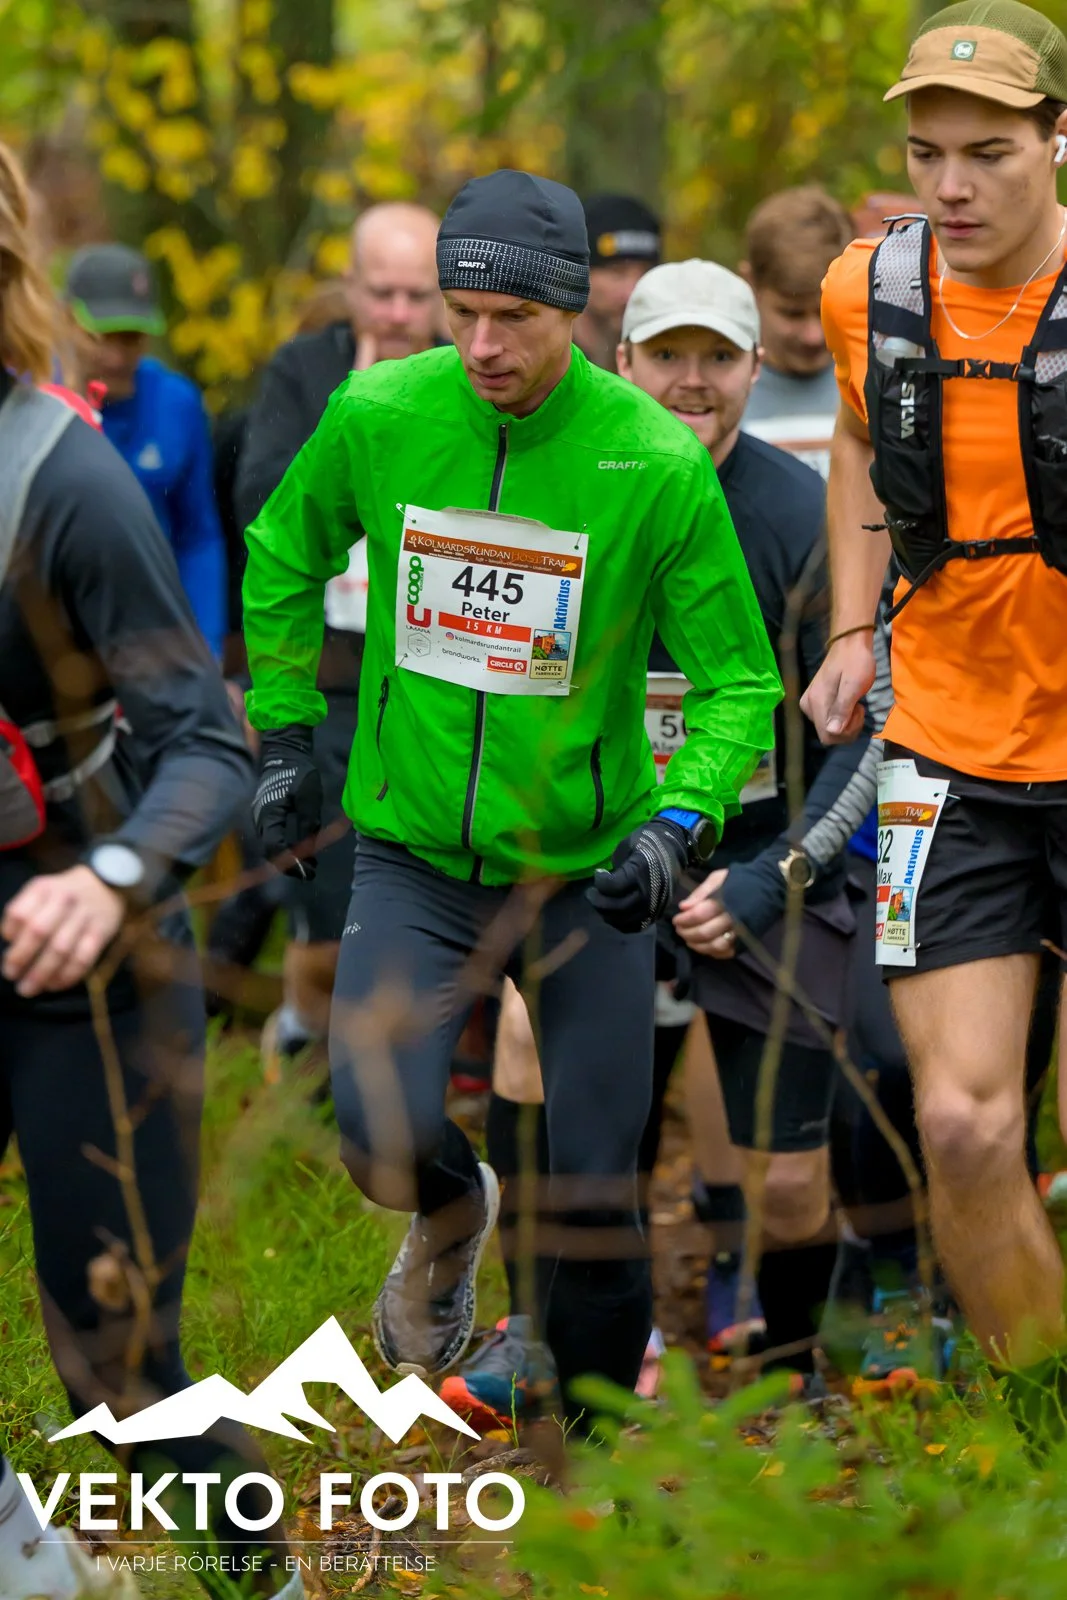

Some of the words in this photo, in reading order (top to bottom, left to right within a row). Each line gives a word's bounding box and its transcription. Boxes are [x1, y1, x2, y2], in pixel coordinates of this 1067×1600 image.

[458, 260, 481, 269] CRAFT
[900, 381, 915, 440] SILVA
[597, 460, 638, 470] CRAFT
[407, 555, 425, 606] coop
[451, 566, 524, 605] 445
[461, 602, 511, 623] Peter
[552, 579, 572, 631] Aktivitus
[486, 624, 503, 634] KM
[454, 632, 522, 654] kolmardsrundantrail
[489, 660, 513, 670] CIRCLE
[903, 829, 924, 885] Aktivitus
